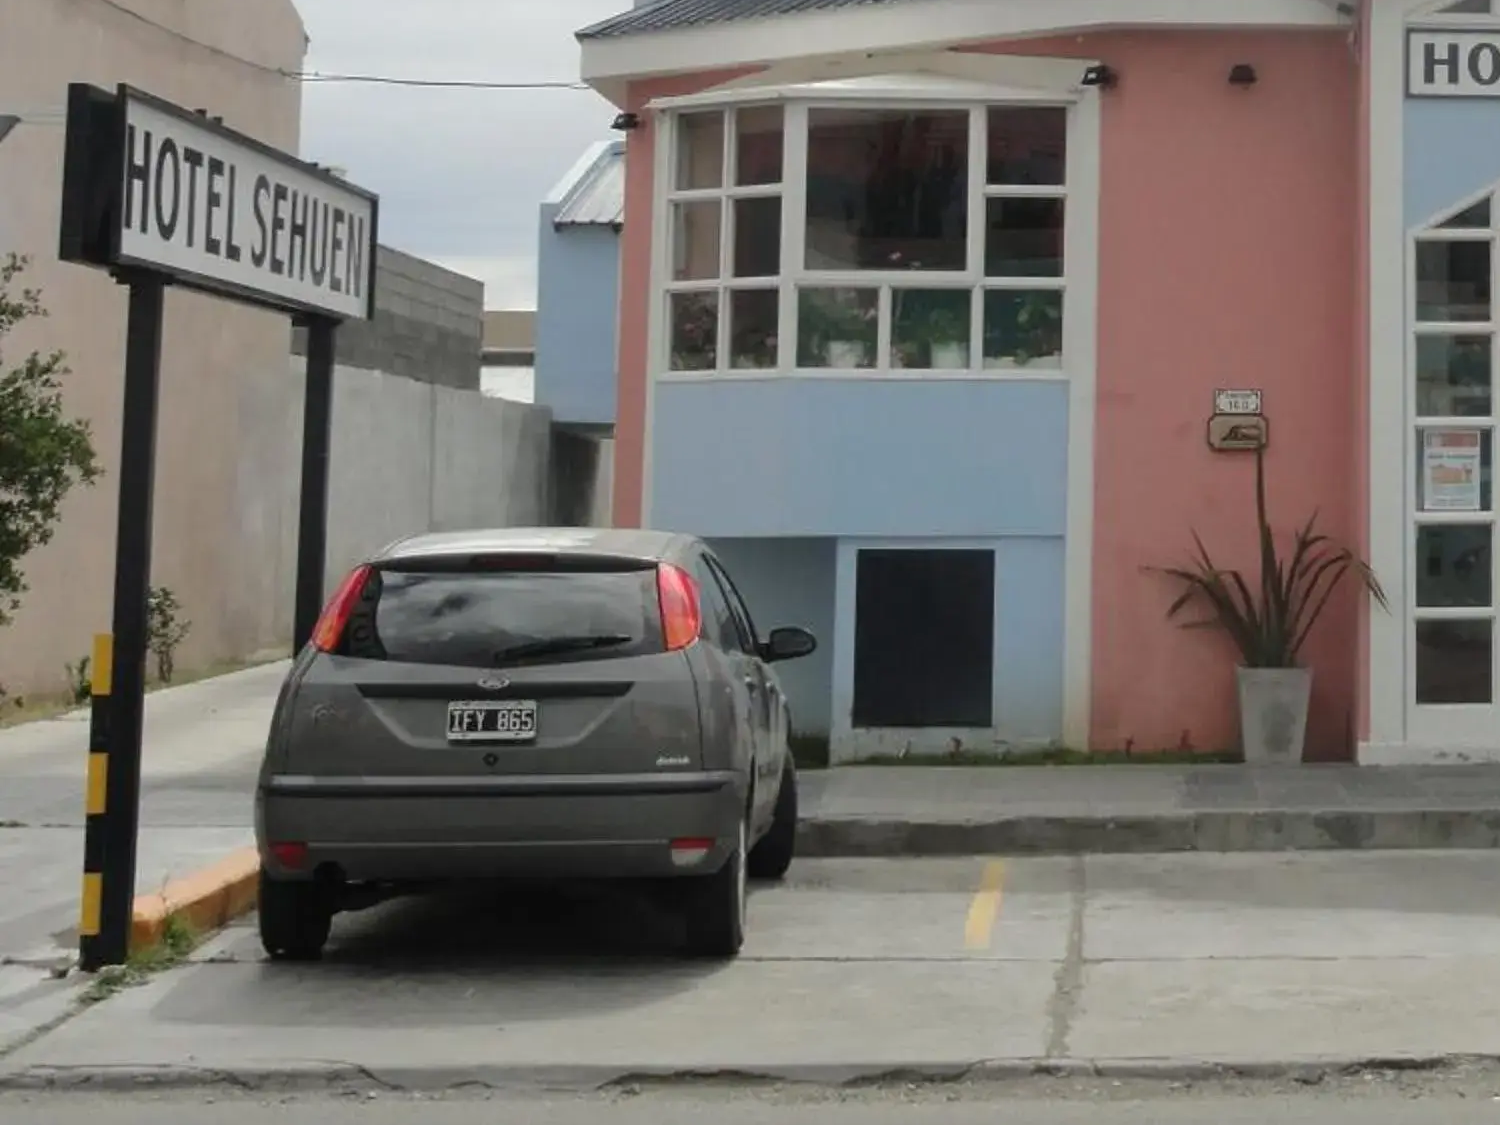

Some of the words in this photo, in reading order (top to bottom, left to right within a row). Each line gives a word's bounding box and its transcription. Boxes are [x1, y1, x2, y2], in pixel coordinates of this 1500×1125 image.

[125, 125, 241, 262] HOTEL
[251, 173, 364, 297] SEHUEN
[452, 710, 486, 732] IFY
[497, 710, 532, 731] 865
